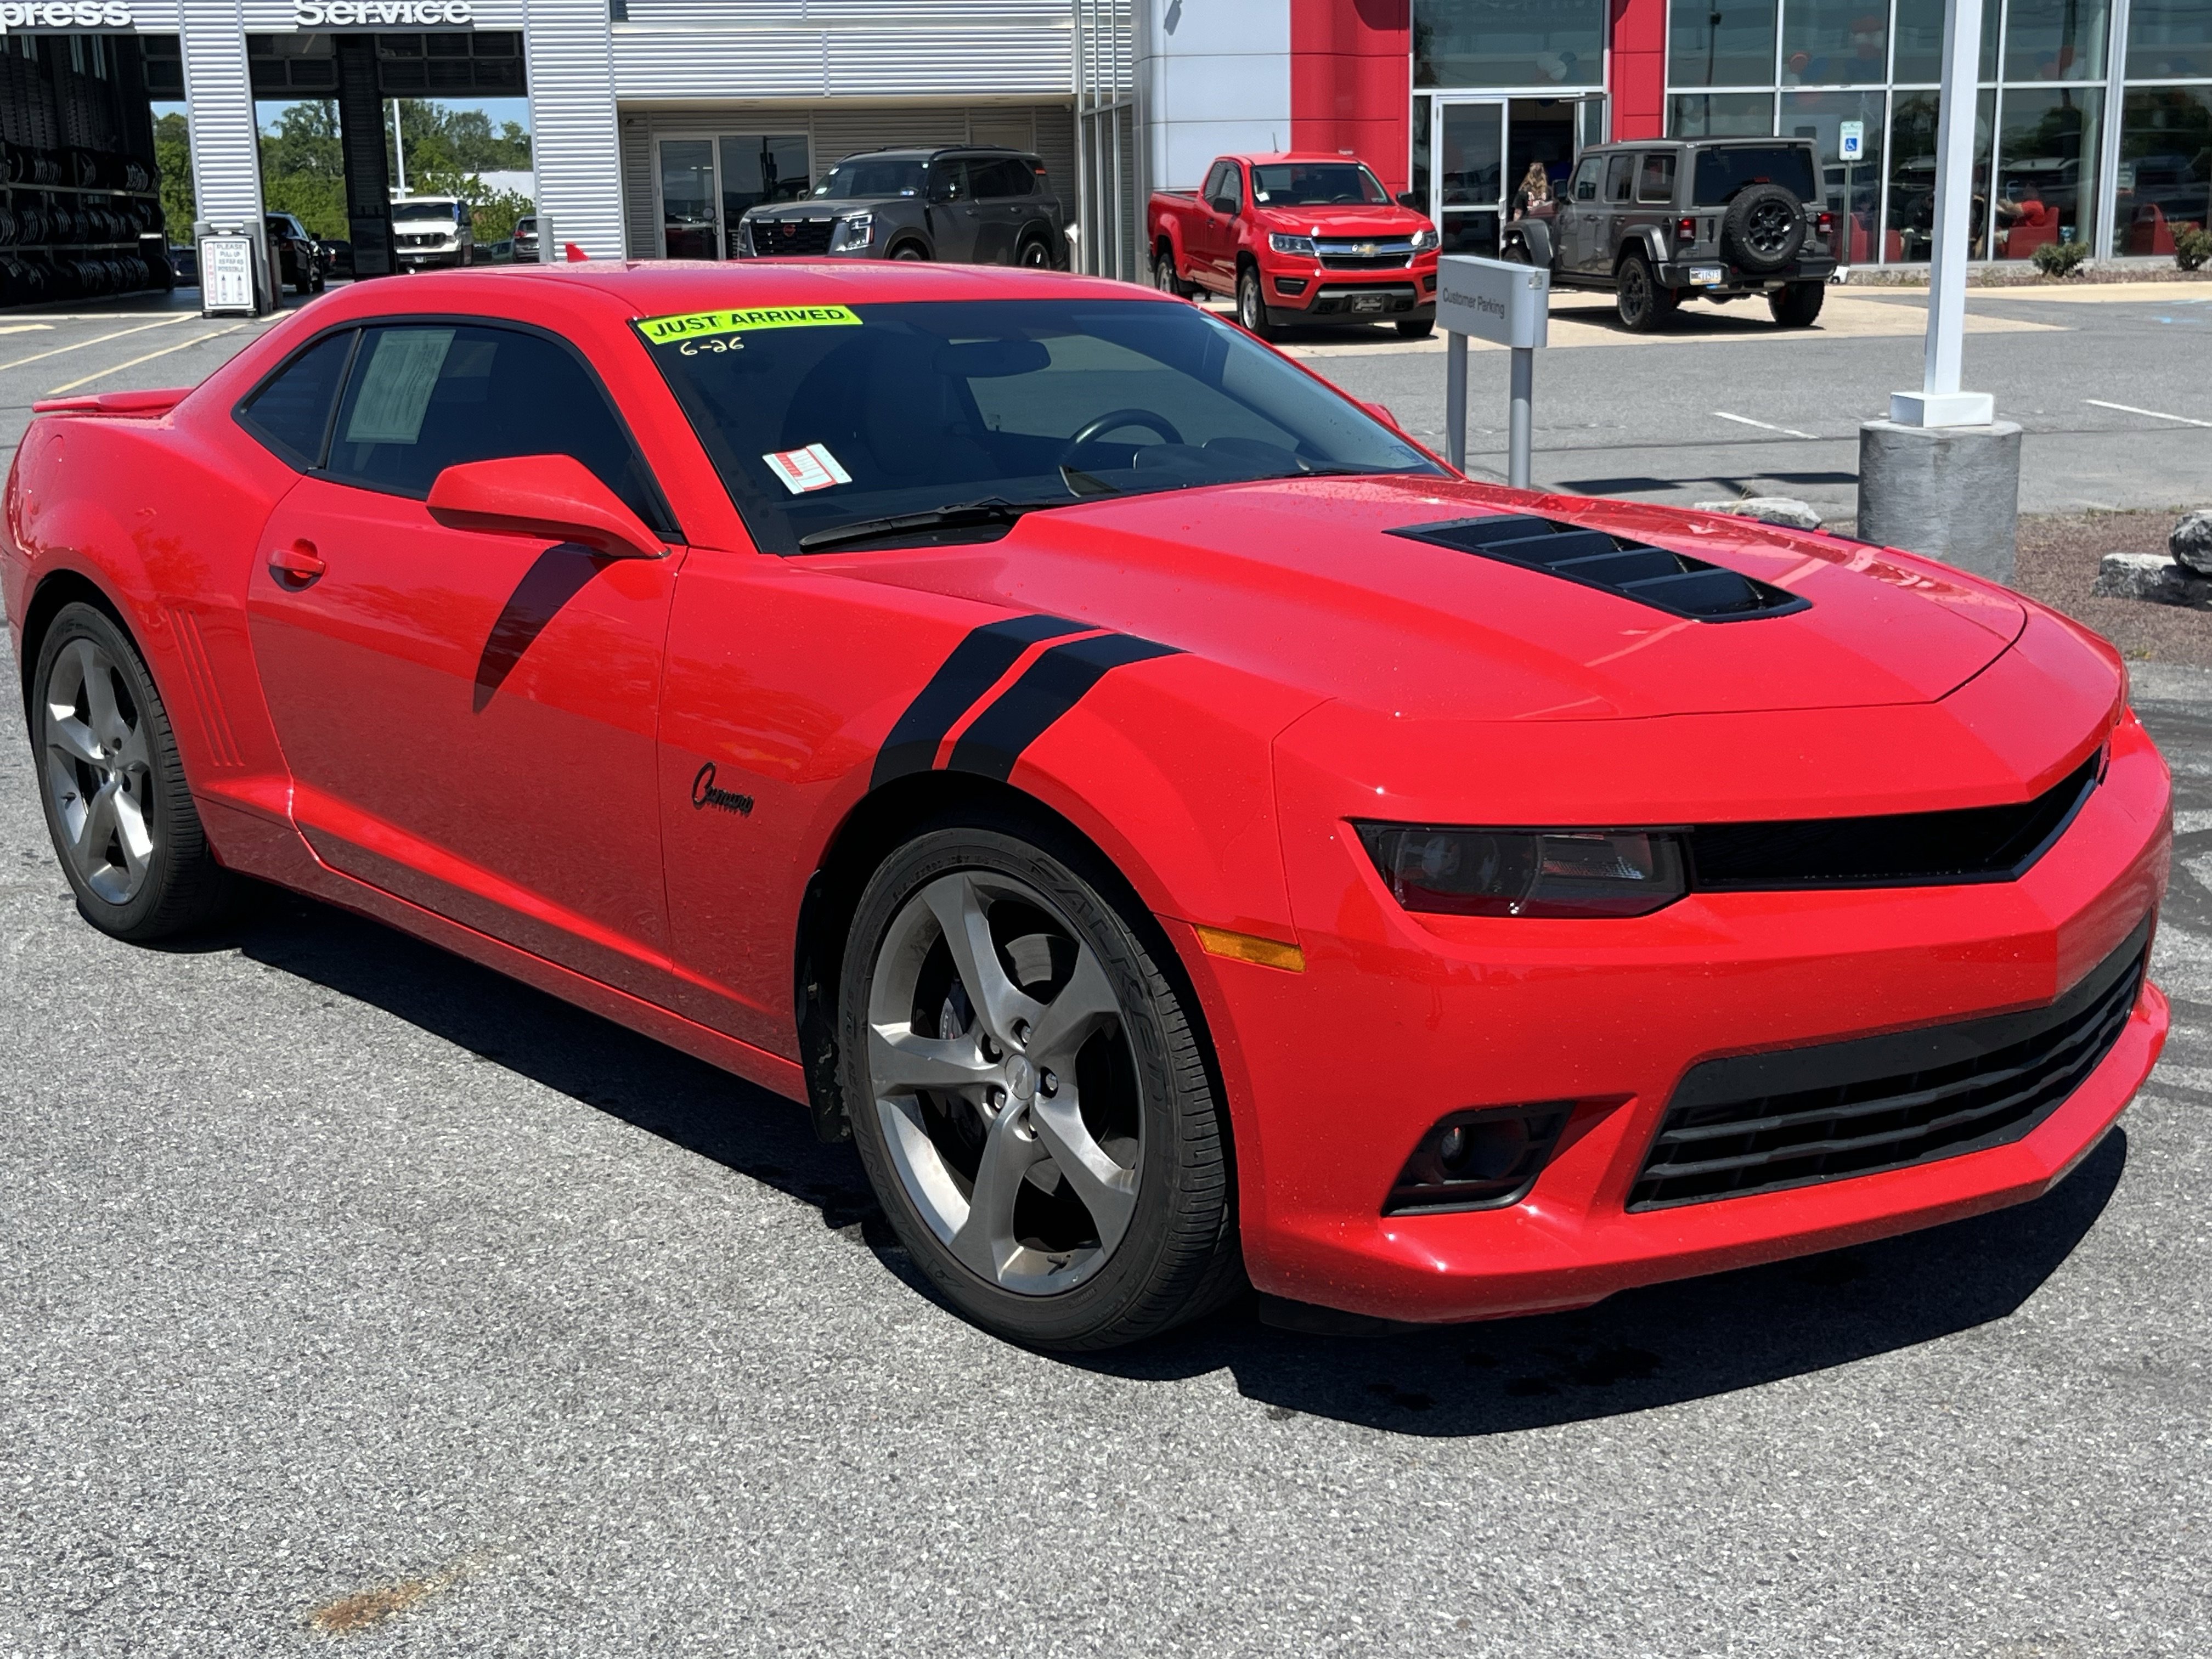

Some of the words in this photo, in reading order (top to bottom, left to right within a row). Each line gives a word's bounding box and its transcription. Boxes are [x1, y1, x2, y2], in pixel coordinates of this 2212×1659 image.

[294, 0, 472, 25] Service
[1443, 287, 1476, 309] Customer
[1477, 296, 1505, 319] Parking
[653, 315, 721, 337] JUST
[731, 309, 847, 325] ARRIVED
[680, 337, 744, 356] 6-26
